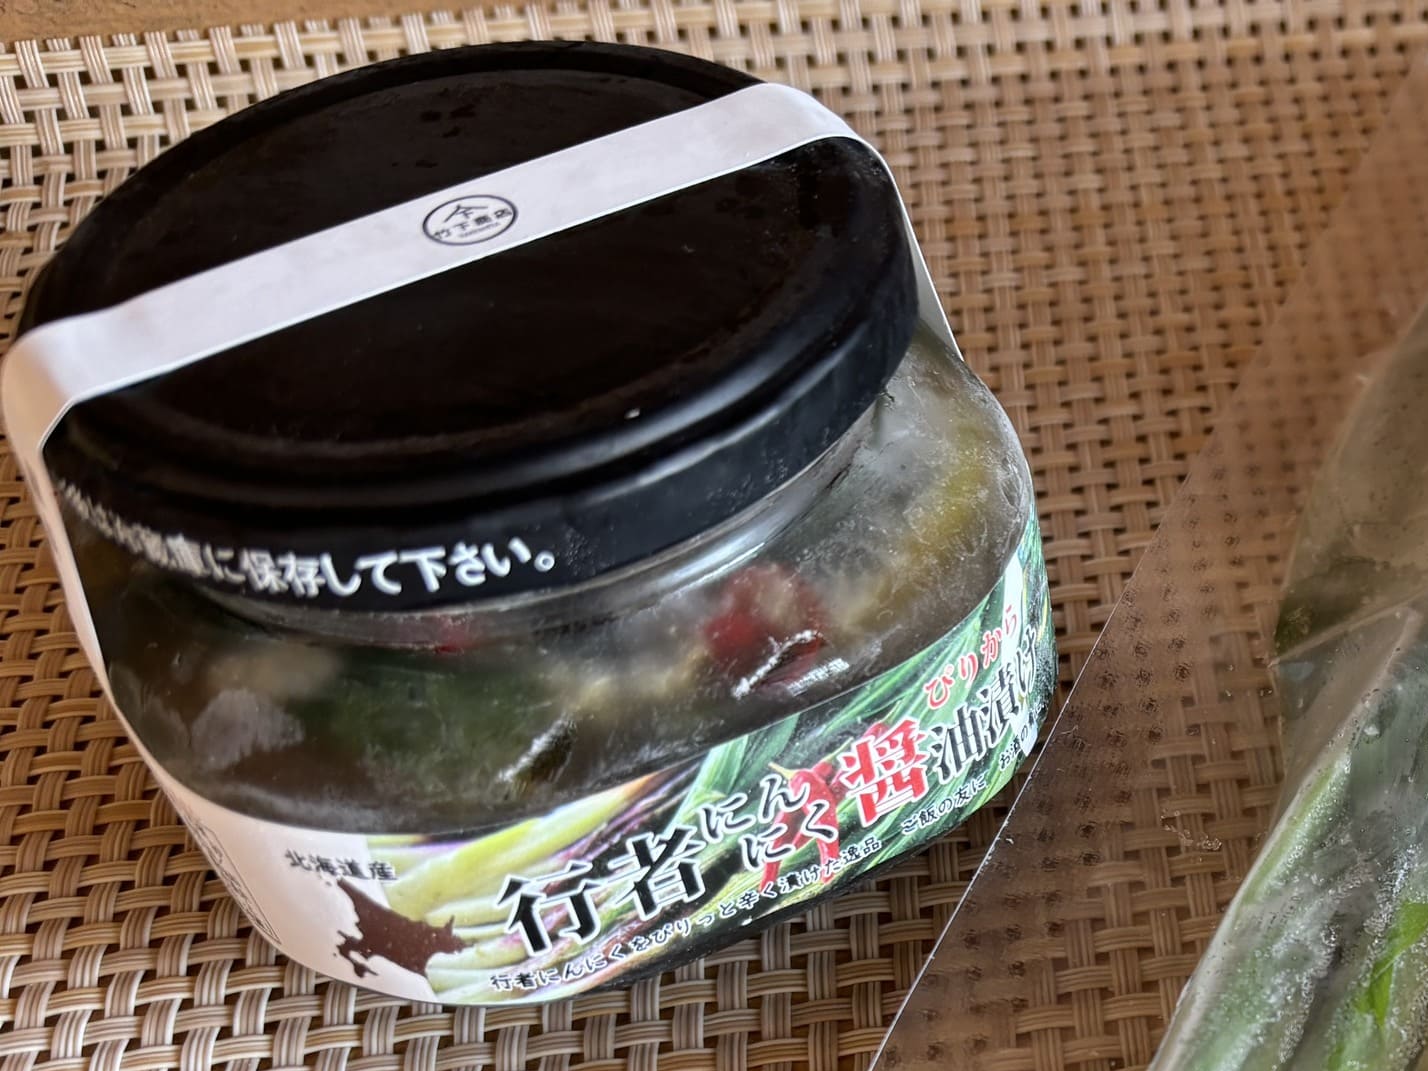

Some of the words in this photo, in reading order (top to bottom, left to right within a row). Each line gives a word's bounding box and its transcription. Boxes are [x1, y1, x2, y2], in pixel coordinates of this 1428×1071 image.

[925, 604, 1018, 708] ぴりから
[902, 774, 987, 834] ご飯の友に
[285, 849, 398, 880] 北海道産
